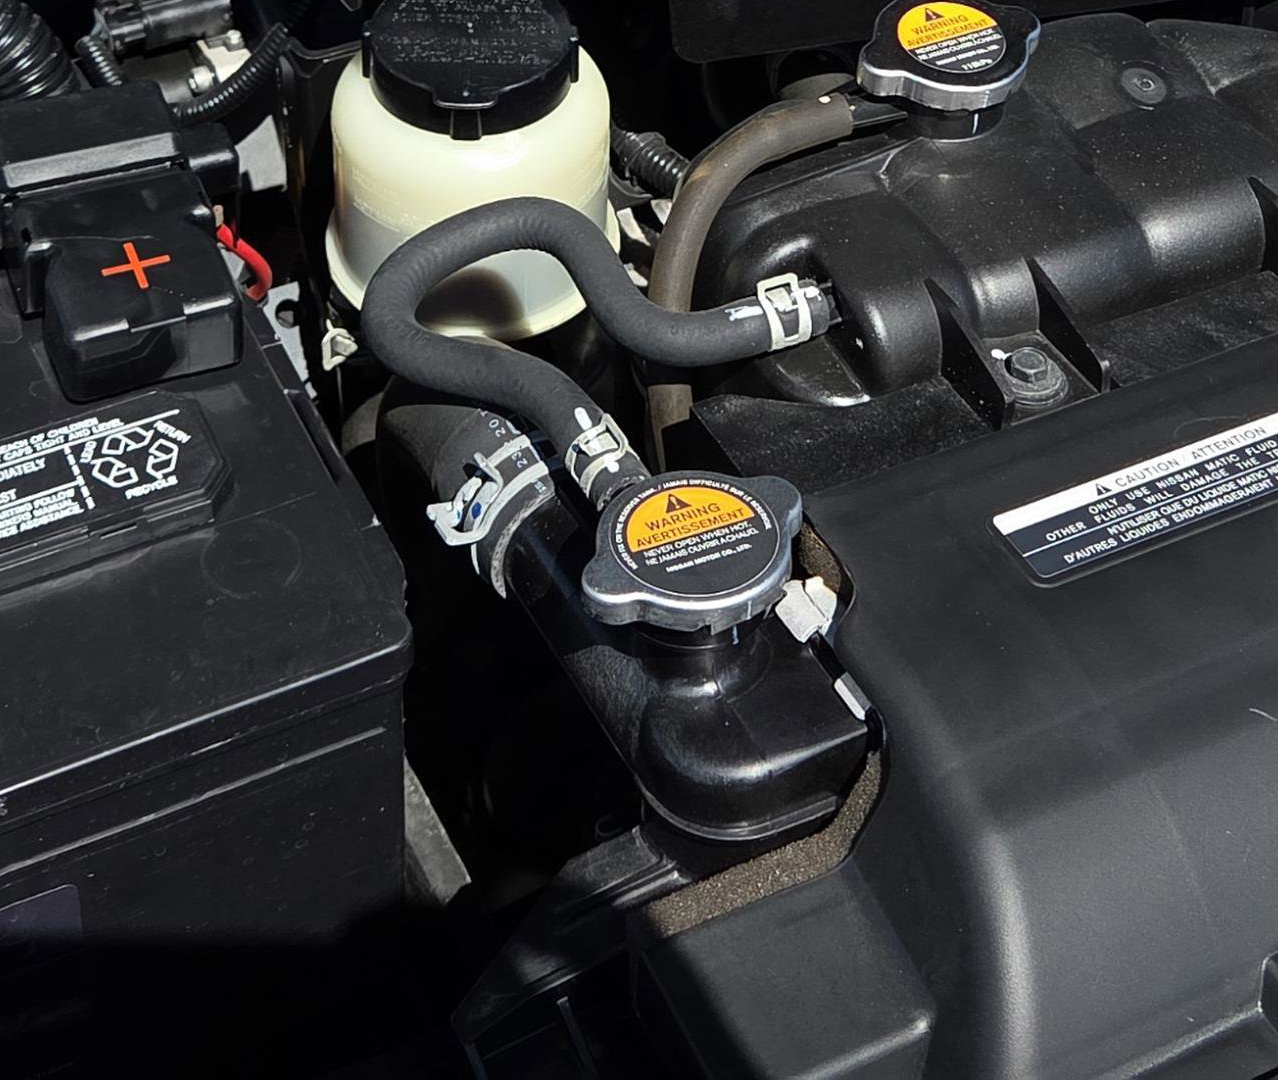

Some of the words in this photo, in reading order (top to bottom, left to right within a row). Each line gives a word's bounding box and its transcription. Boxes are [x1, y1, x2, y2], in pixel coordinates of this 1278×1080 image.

[907, 18, 989, 46] AVERTISSEMENT
[911, 14, 969, 36] WARNING
[1088, 497, 1117, 514] ONLY
[1124, 486, 1150, 500] USE
[1155, 468, 1199, 488] NISSAN
[1204, 453, 1239, 470] MATIC
[1244, 439, 1277, 456] FLUID
[1114, 458, 1179, 487] CAUTION
[1191, 426, 1266, 459] ATTENTION
[1045, 521, 1086, 541] OTHER
[1093, 503, 1135, 523] FLUIDS
[1142, 490, 1173, 504] WILL
[1179, 468, 1228, 491] DAMAGE
[1234, 456, 1260, 469] THE
[1159, 501, 1184, 515] QUE
[1181, 495, 1199, 507] DU
[1197, 481, 1238, 500] LIQUIDE
[1236, 469, 1268, 486] MATIC
[636, 508, 746, 548] AVERTISSEMENT
[644, 503, 721, 531] WARNING
[1063, 537, 1117, 563] D'AUTRES
[1119, 517, 1169, 541] LIQUIDES
[1171, 478, 1272, 521] ENDOMMAGERAIENT
[643, 544, 674, 558] NEVER
[674, 535, 701, 549] OPEN
[700, 526, 730, 540] WHEN
[645, 557, 659, 566] NE
[659, 548, 688, 564] JAMAIS
[687, 538, 721, 554] OUVRIR
